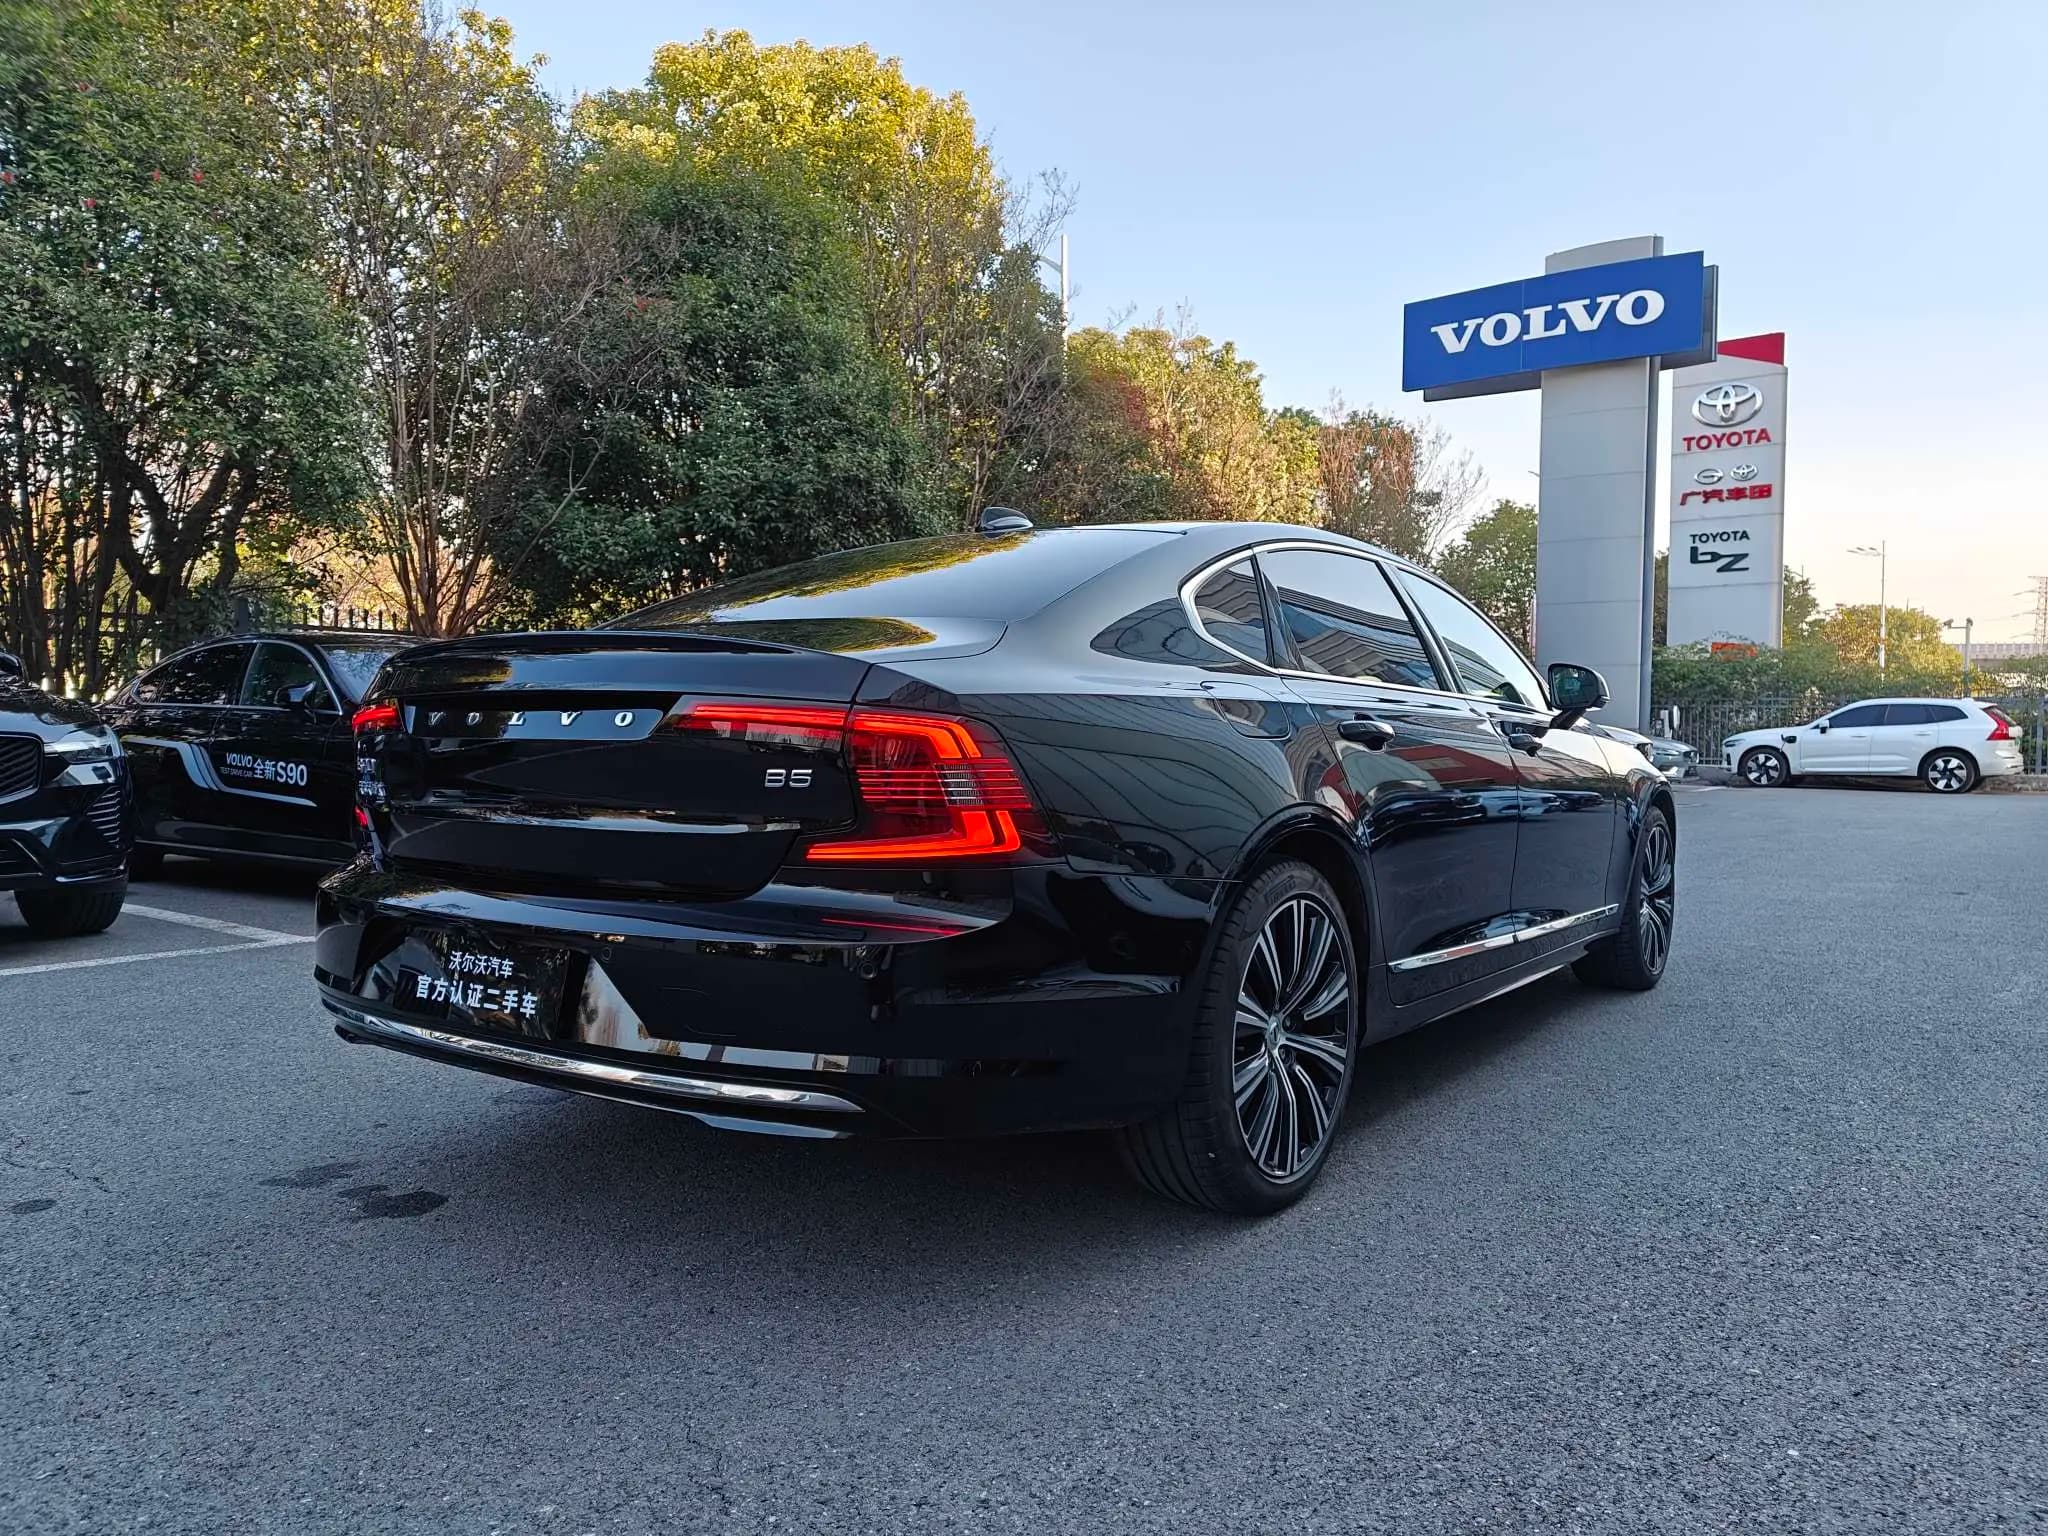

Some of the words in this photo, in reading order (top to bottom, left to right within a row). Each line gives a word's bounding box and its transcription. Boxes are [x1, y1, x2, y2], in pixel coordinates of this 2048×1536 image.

[1431, 289, 1665, 354] VOLVO
[1682, 428, 1772, 451] TOYOTA
[1690, 530, 1750, 544] TOYOTA
[428, 711, 634, 727] VOLVO
[226, 752, 253, 767] VOLVO
[764, 768, 813, 788] B5
[449, 951, 514, 979] 沃尔沃汽车
[416, 974, 538, 1018] 官方认证二手车
